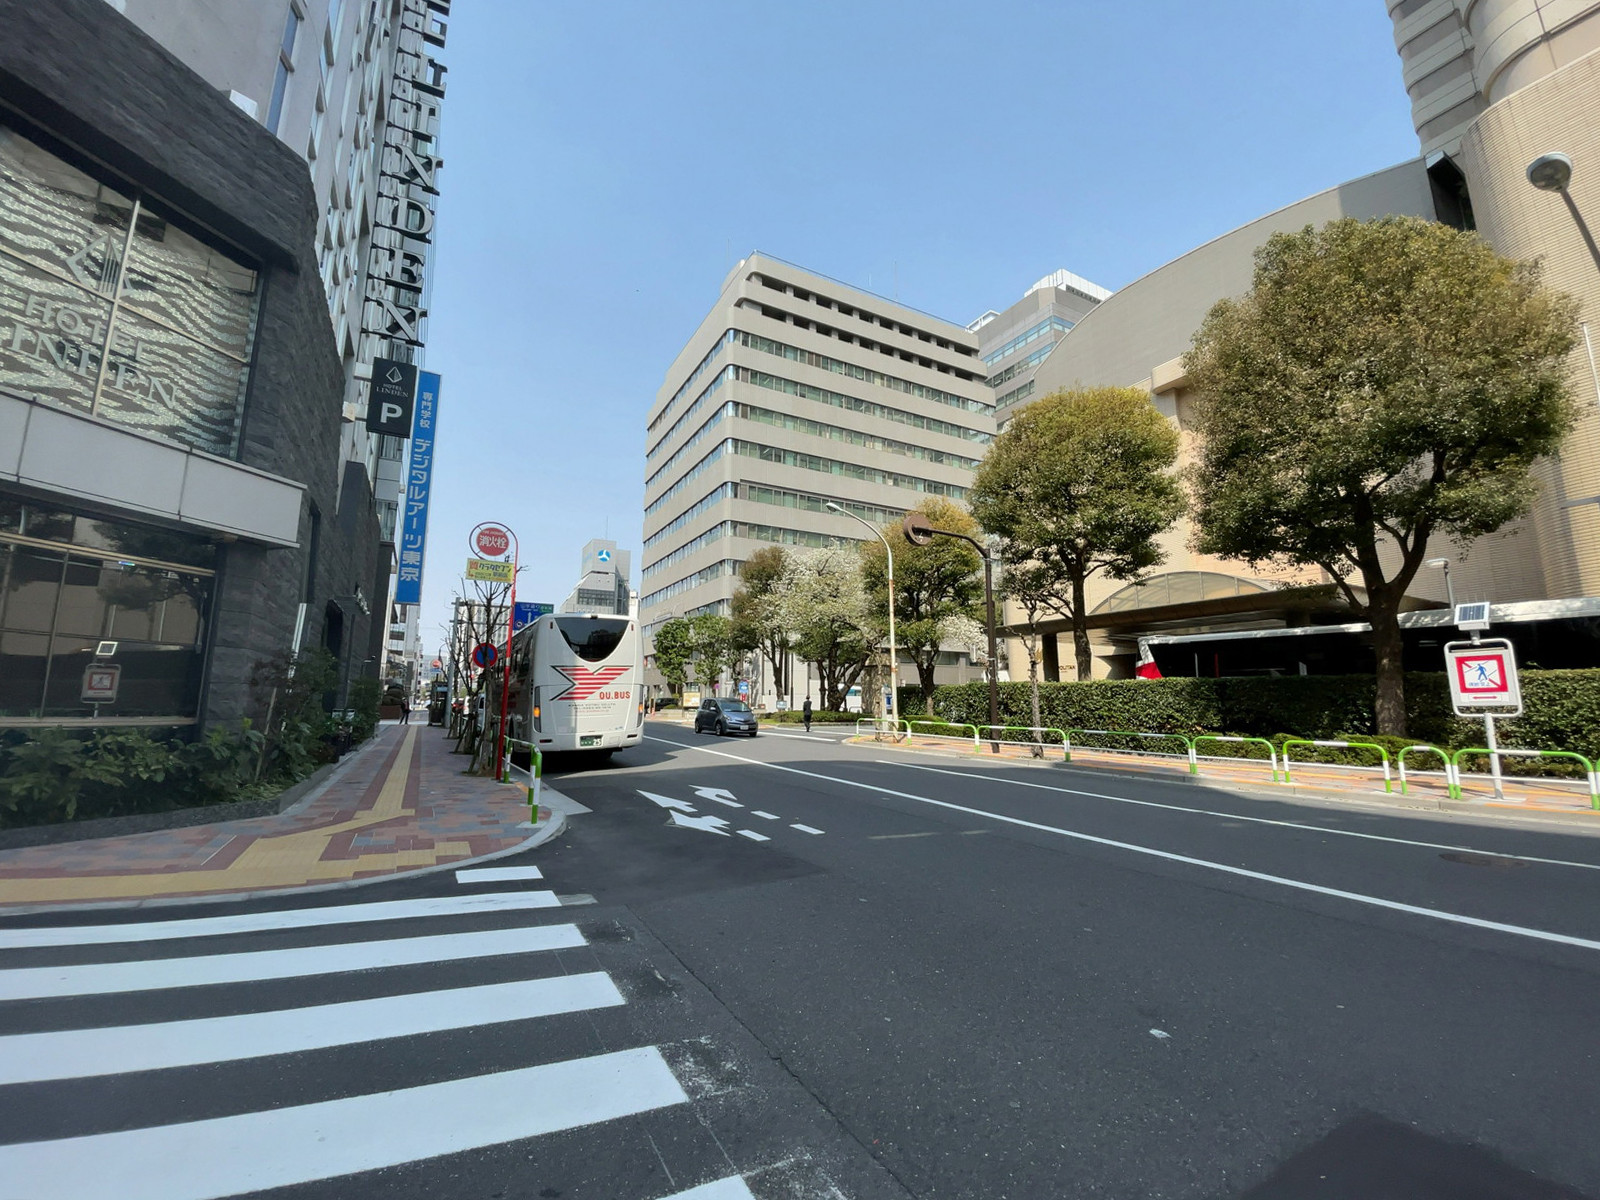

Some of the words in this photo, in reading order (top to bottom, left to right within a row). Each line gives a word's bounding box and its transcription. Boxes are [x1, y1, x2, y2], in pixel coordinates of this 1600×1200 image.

[373, 52, 448, 347] LINDEN
[25, 294, 152, 366] HOTEL
[376, 386, 408, 398] LINDEN
[383, 383, 402, 391] HOTEL
[380, 402, 403, 424] P
[420, 391, 434, 429] 専門学校
[400, 438, 432, 582] デジタルアーツ東京
[480, 535, 507, 549] 消火栓
